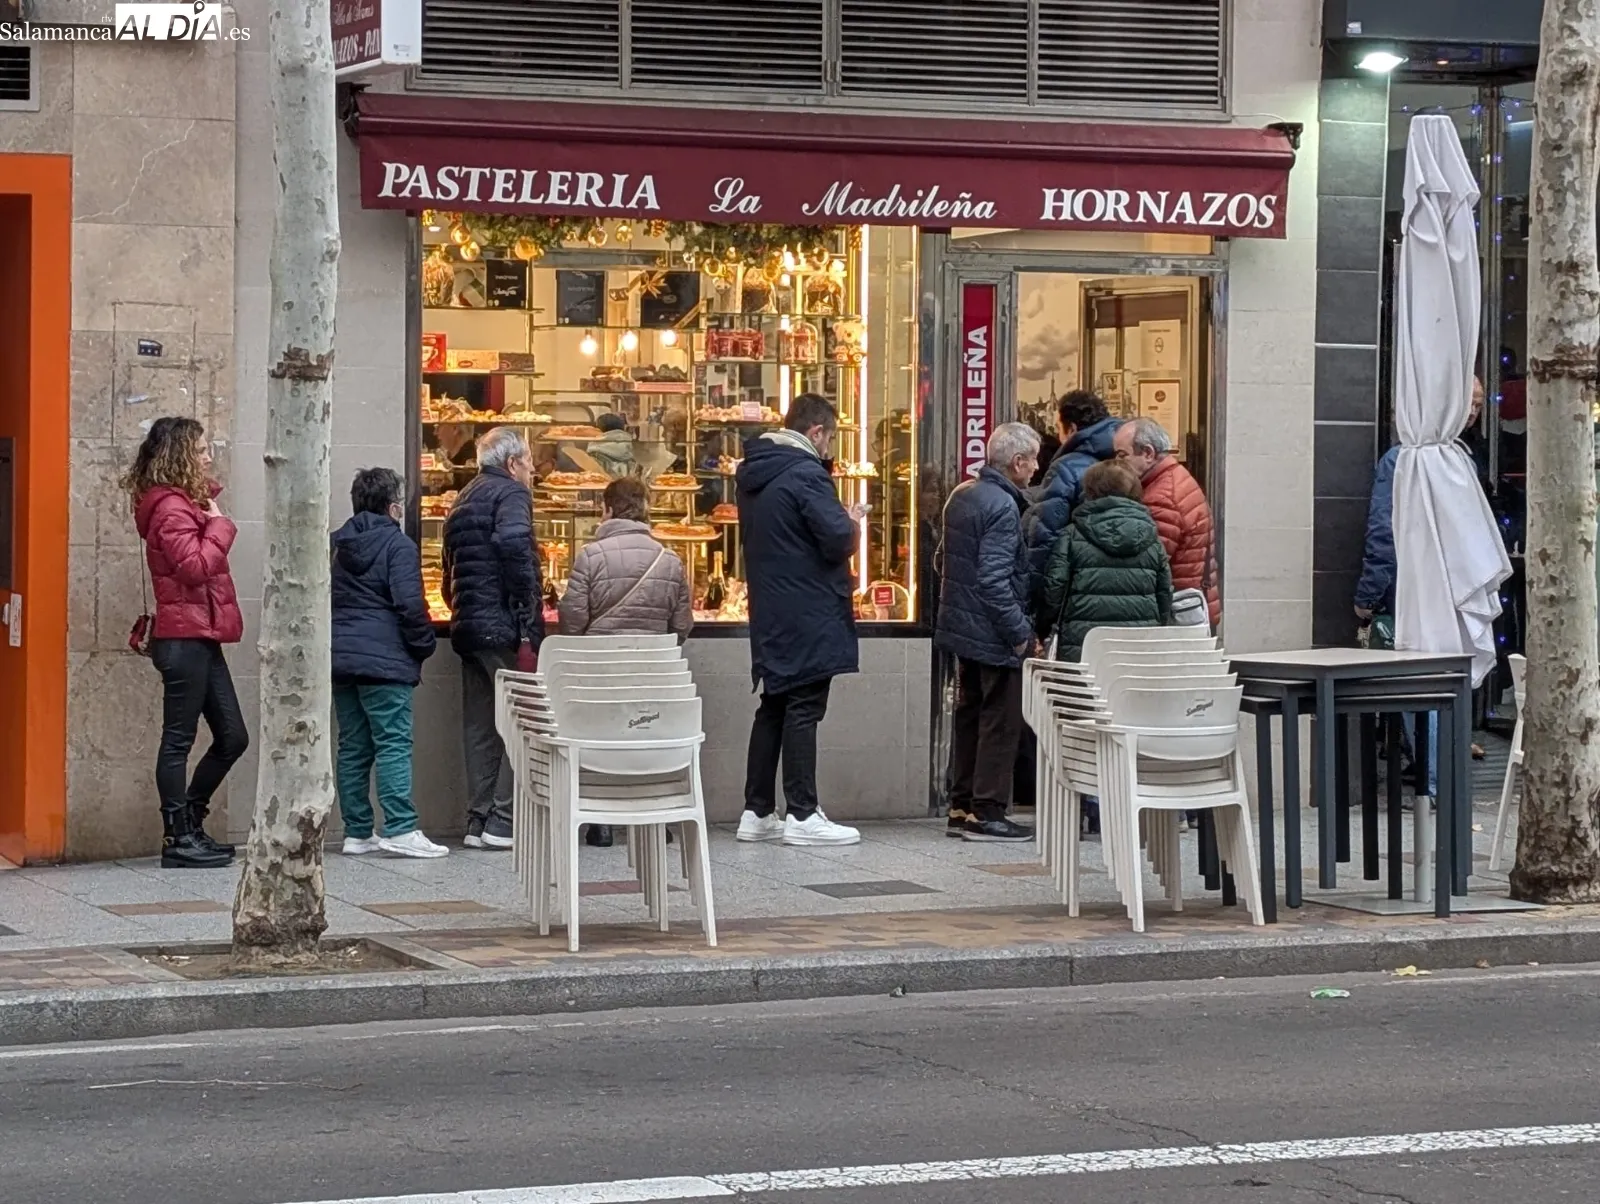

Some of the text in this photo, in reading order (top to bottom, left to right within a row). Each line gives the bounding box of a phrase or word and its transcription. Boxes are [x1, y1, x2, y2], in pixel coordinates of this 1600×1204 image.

[377, 161, 1277, 229] PASTELERIA La Madrileña HORNAZOS
